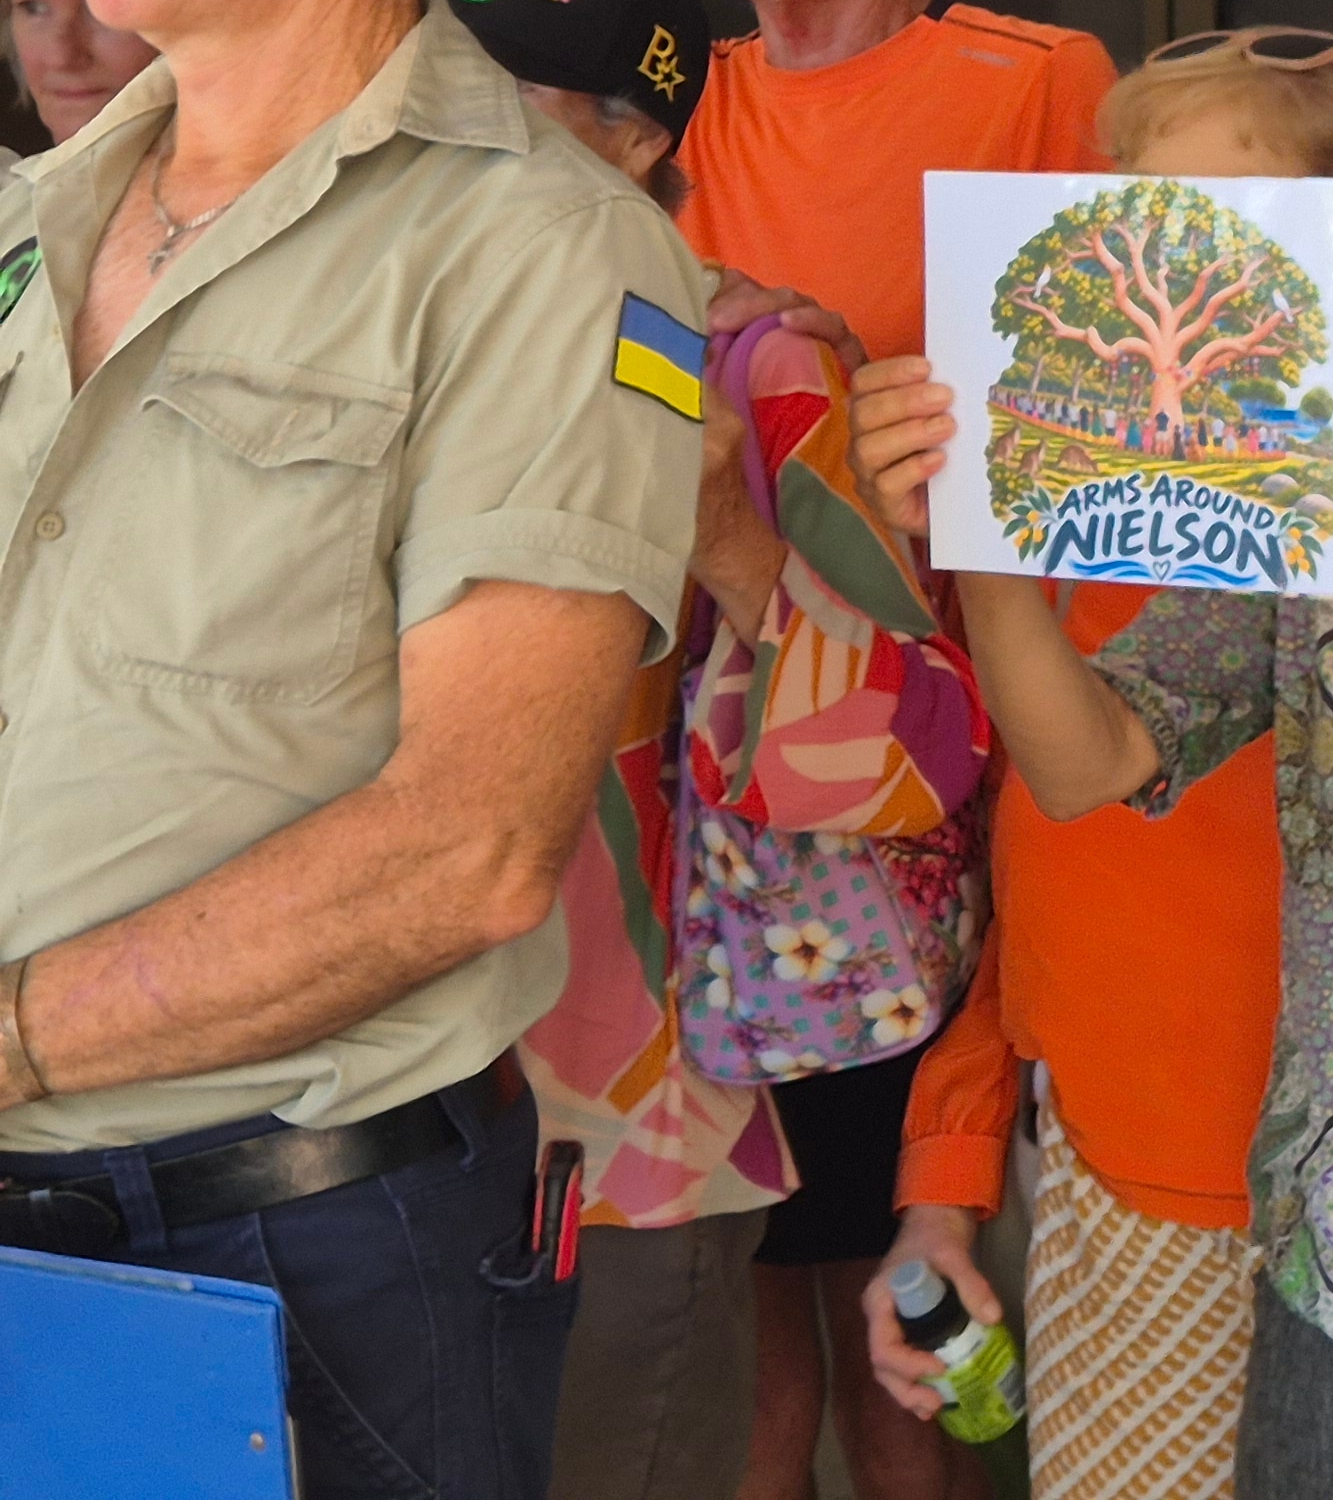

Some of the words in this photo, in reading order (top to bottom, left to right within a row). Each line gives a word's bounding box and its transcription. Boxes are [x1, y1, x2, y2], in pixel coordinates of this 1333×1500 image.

[1057, 473, 1141, 519] ARMS
[1150, 473, 1276, 530] AROUND
[1044, 509, 1288, 590] NIELSON
